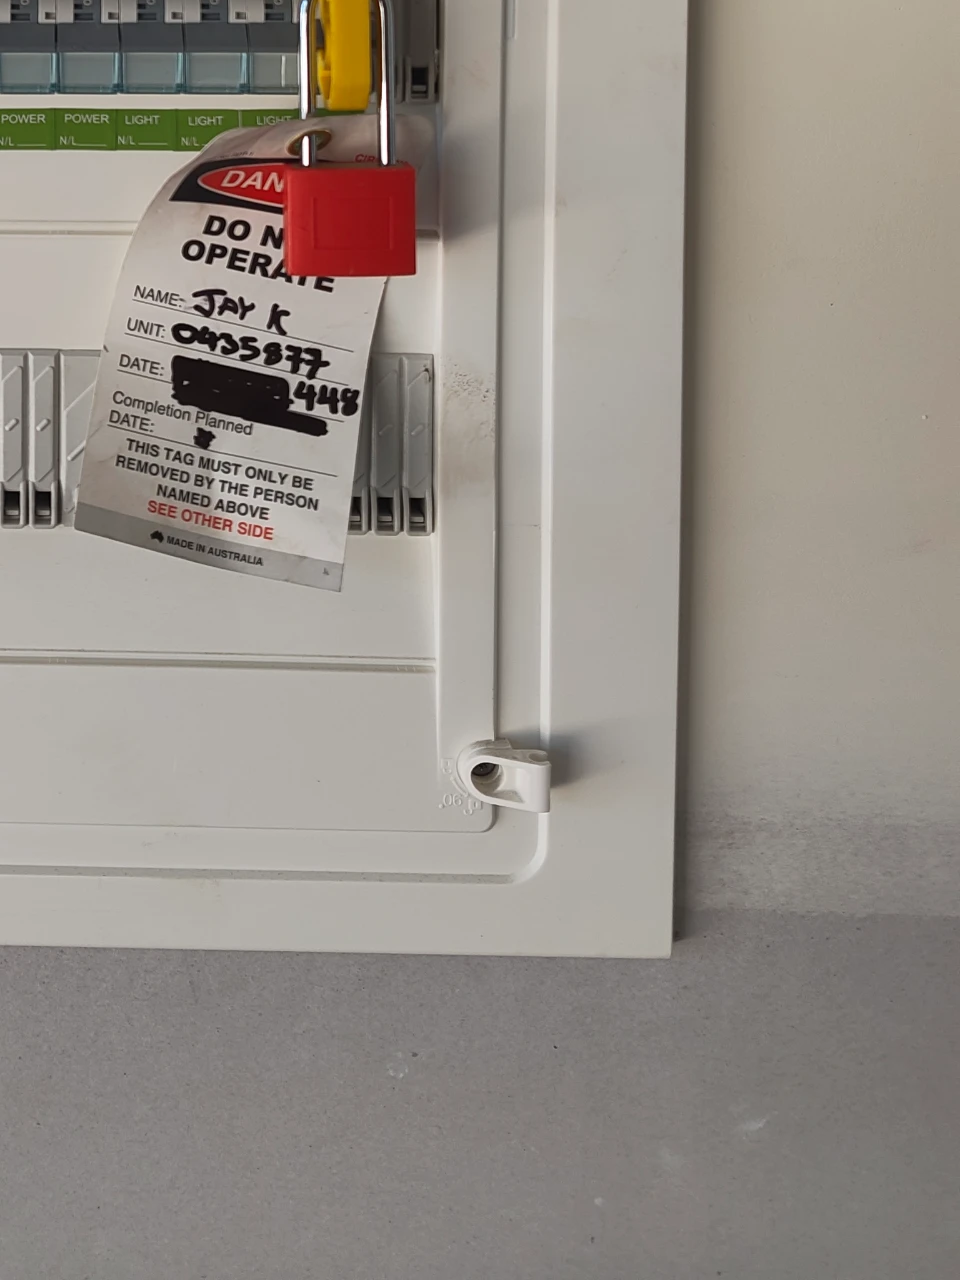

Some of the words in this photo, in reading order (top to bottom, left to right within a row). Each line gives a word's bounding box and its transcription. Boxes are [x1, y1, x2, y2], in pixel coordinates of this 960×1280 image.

[1, 113, 46, 124] POWER
[64, 113, 110, 124] POWER
[125, 115, 161, 125] LIGHT
[188, 115, 224, 126] LIGHT
[202, 214, 251, 242] DO
[133, 285, 182, 309] NAME:
[192, 288, 256, 322] JAY
[266, 303, 292, 337] K
[126, 317, 166, 339] UNIT:
[118, 353, 165, 377] DATE:
[171, 322, 330, 380] 0435877
[112, 390, 191, 422] Completion
[195, 412, 254, 437] Planned
[292, 380, 361, 417] 448
[108, 409, 155, 434] DATE:
[126, 438, 160, 458] THIS
[164, 446, 195, 467] TAG
[198, 454, 242, 476] MUST
[244, 465, 288, 486] ONLY
[291, 474, 315, 492] BE
[115, 454, 190, 484] REMOVED
[193, 475, 216, 491] BY
[218, 479, 249, 498] THE
[253, 486, 319, 512] PERSON
[156, 483, 211, 509] NAMED
[214, 500, 270, 522] ABOVE
[147, 499, 177, 520] SEE
[180, 507, 233, 533] OTHER
[236, 520, 275, 542] SIDE
[166, 535, 194, 552] MADE
[195, 542, 206, 555] IN
[207, 545, 265, 568] AUSTRALIA
